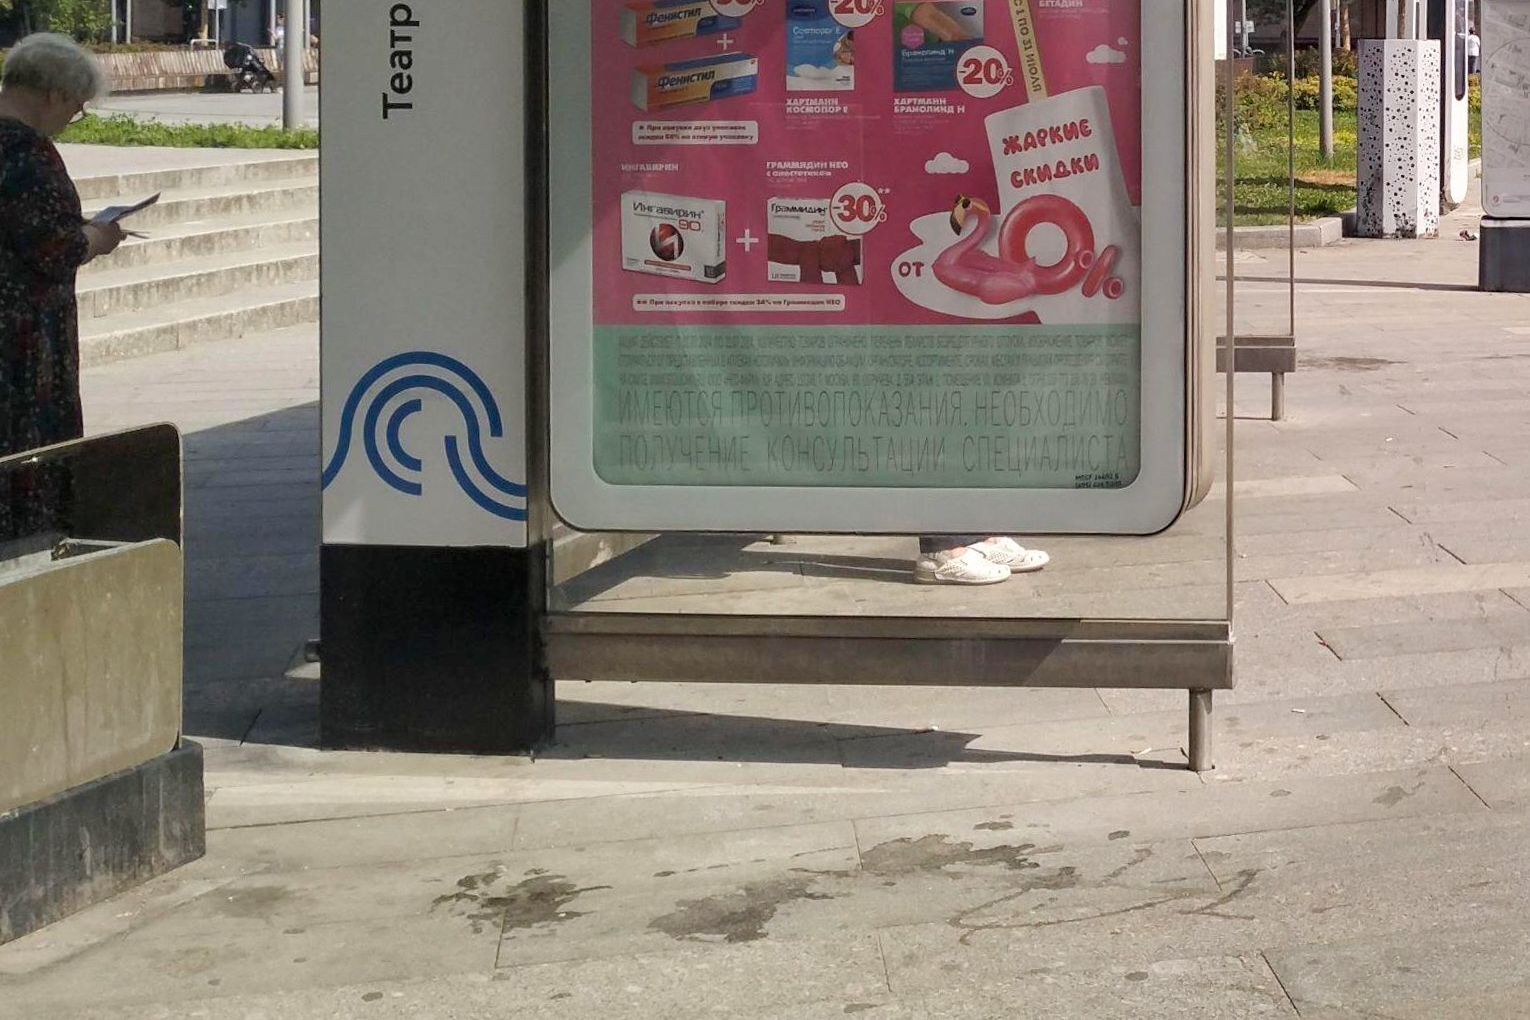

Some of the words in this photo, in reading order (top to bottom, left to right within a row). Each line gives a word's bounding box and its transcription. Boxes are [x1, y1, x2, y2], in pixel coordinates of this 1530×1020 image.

[1038, 0, 1084, 8] БЕТАДИН
[382, 3, 419, 119] Театр
[657, 69, 716, 89] Фенистил
[893, 97, 947, 106] ХАРТМАНН
[1003, 118, 1092, 156] ЖАРКИЕ
[1010, 153, 1100, 189] СКИДКИ
[678, 220, 701, 231] 90
[618, 390, 722, 429] ИМЕЮТСЯ
[731, 389, 968, 428] ПРОТИВОПОКАЗАНИЯ.
[976, 389, 1128, 431] НЕОБХОДИМО
[619, 435, 751, 472] ПОЛУЧЕНИЕ
[767, 435, 946, 477] КОНСУЛЬТАЦИИ
[962, 434, 1128, 478] СПЕЦИАЛИСТА
